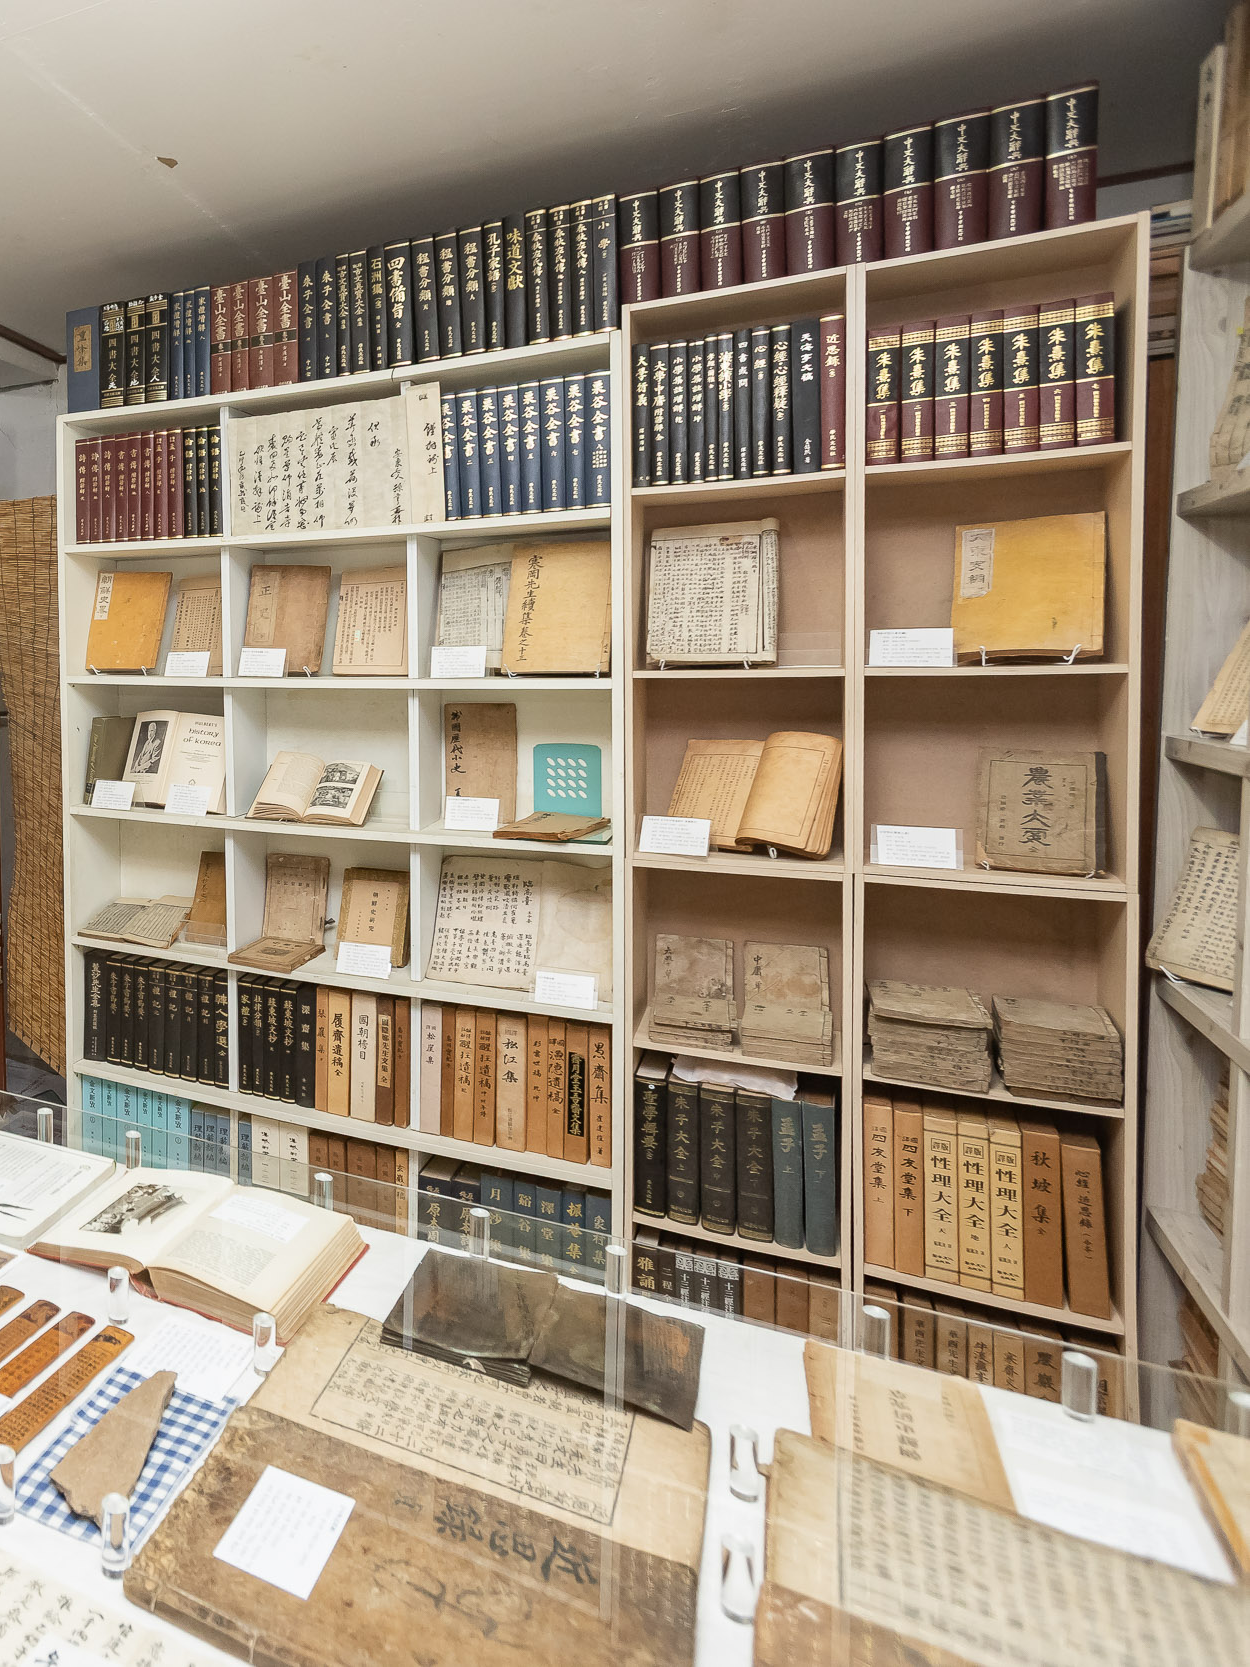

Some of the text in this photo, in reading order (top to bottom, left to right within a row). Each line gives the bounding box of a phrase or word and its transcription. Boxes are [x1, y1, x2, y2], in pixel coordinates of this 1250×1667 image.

[955, 123, 970, 172] 中文大辭典
[1008, 110, 1023, 160] 中文大辭典
[1065, 97, 1081, 148] 中文大辭典
[803, 160, 816, 206] 中文大辭典
[854, 149, 867, 196] 中文大辭典
[903, 136, 918, 185] 中文大辭典
[673, 189, 685, 233] 中文大辭典
[713, 180, 726, 224] 中文大辭典
[756, 170, 770, 214] 中文大辭典
[632, 199, 642, 242] 中文大辭典
[506, 228, 524, 290] 味道文獻
[754, 344, 767, 369] 心經
[908, 347, 926, 397] 朱熹集
[944, 343, 962, 392] 朱熹集
[977, 337, 995, 388] 朱熹集
[1012, 333, 1030, 384] 朱熹集
[1048, 327, 1067, 379] 朱熹集
[1085, 321, 1104, 374] 朱熹集
[875, 351, 893, 400] 朱熹集
[461, 399, 477, 457] 栗谷全書
[482, 396, 498, 455] 栗谷全書
[502, 393, 519, 452] 栗谷全書
[522, 390, 539, 450] 栗谷全書
[544, 386, 561, 447] 栗谷全書
[567, 383, 584, 445] 栗谷全書
[591, 379, 609, 442] 栗谷全書
[674, 1096, 690, 1160] 朱子大全
[710, 1103, 727, 1169] 朱子大全
[778, 1117, 795, 1153] 孟子
[811, 1123, 828, 1160] 孟子
[930, 1155, 952, 1224] 性理大全
[963, 1159, 985, 1230] 性理大全
[995, 1169, 1018, 1239] 性理大全
